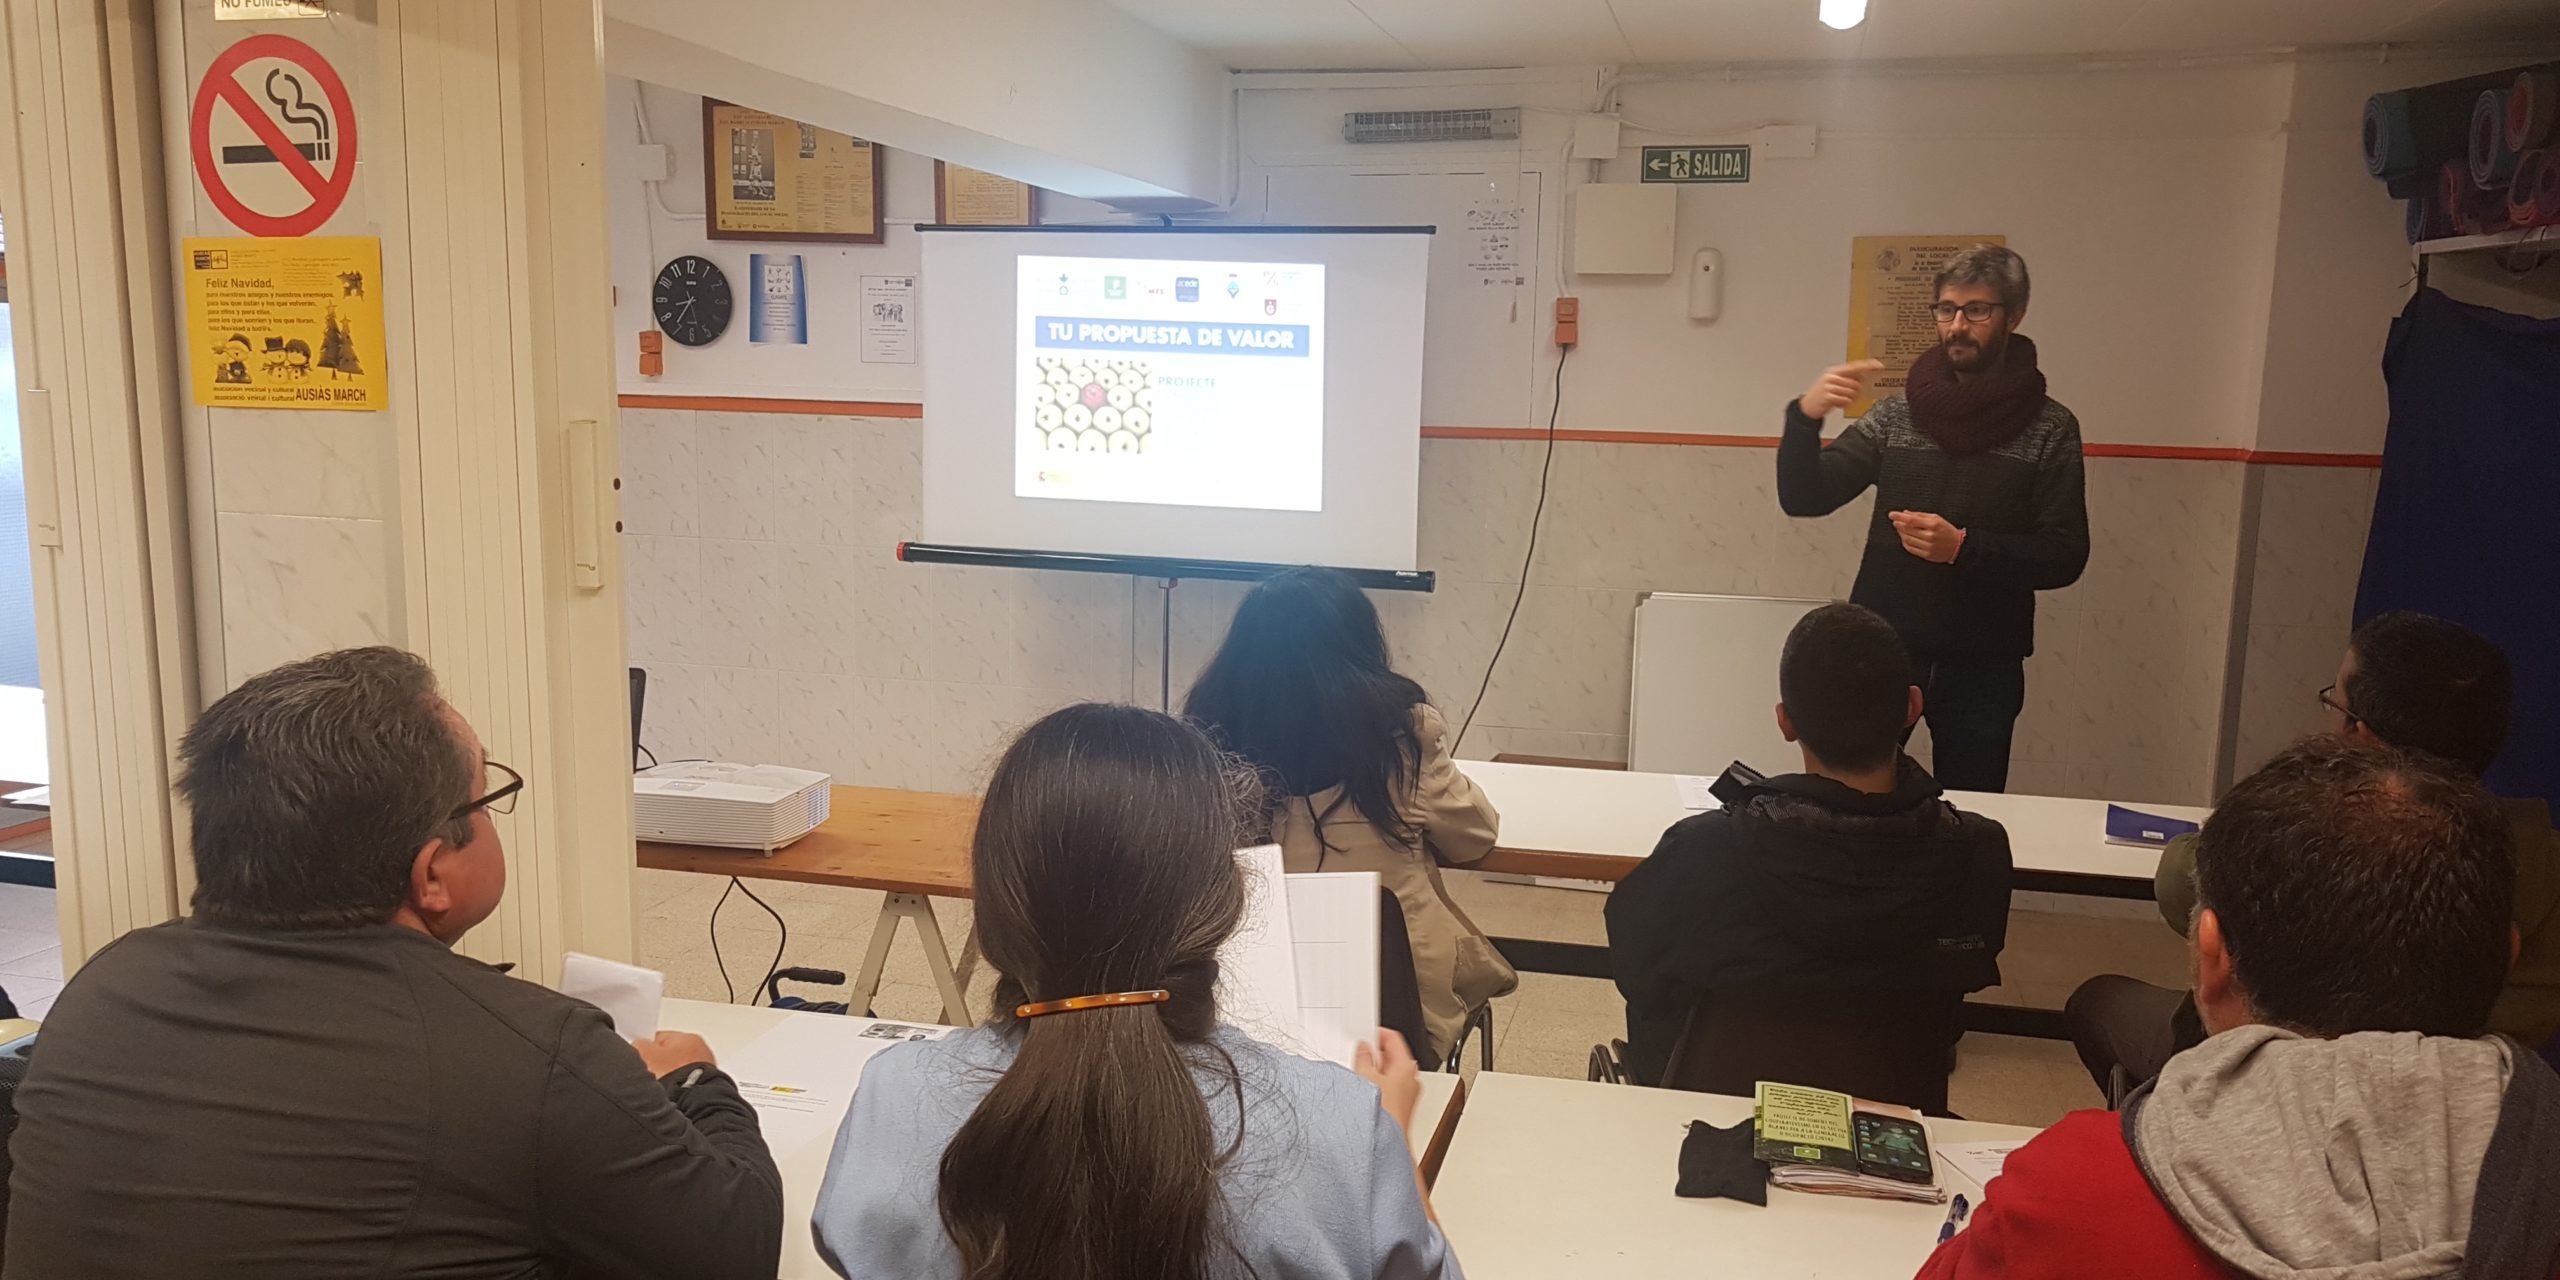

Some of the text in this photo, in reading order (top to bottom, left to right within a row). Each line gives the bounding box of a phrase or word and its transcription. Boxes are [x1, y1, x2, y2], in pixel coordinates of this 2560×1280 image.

[221, 0, 240, 8] NO
[1694, 153, 1741, 176] SALIDA
[670, 263, 682, 278] 11
[686, 259, 696, 274] 12
[702, 265, 710, 278] 1
[206, 278, 274, 289] Feliz Navidad,
[659, 276, 672, 289] 10
[660, 312, 672, 322] 8
[1048, 322, 1295, 349] TU PROPUESTA DE VALOR
[333, 388, 366, 402] MARCH
